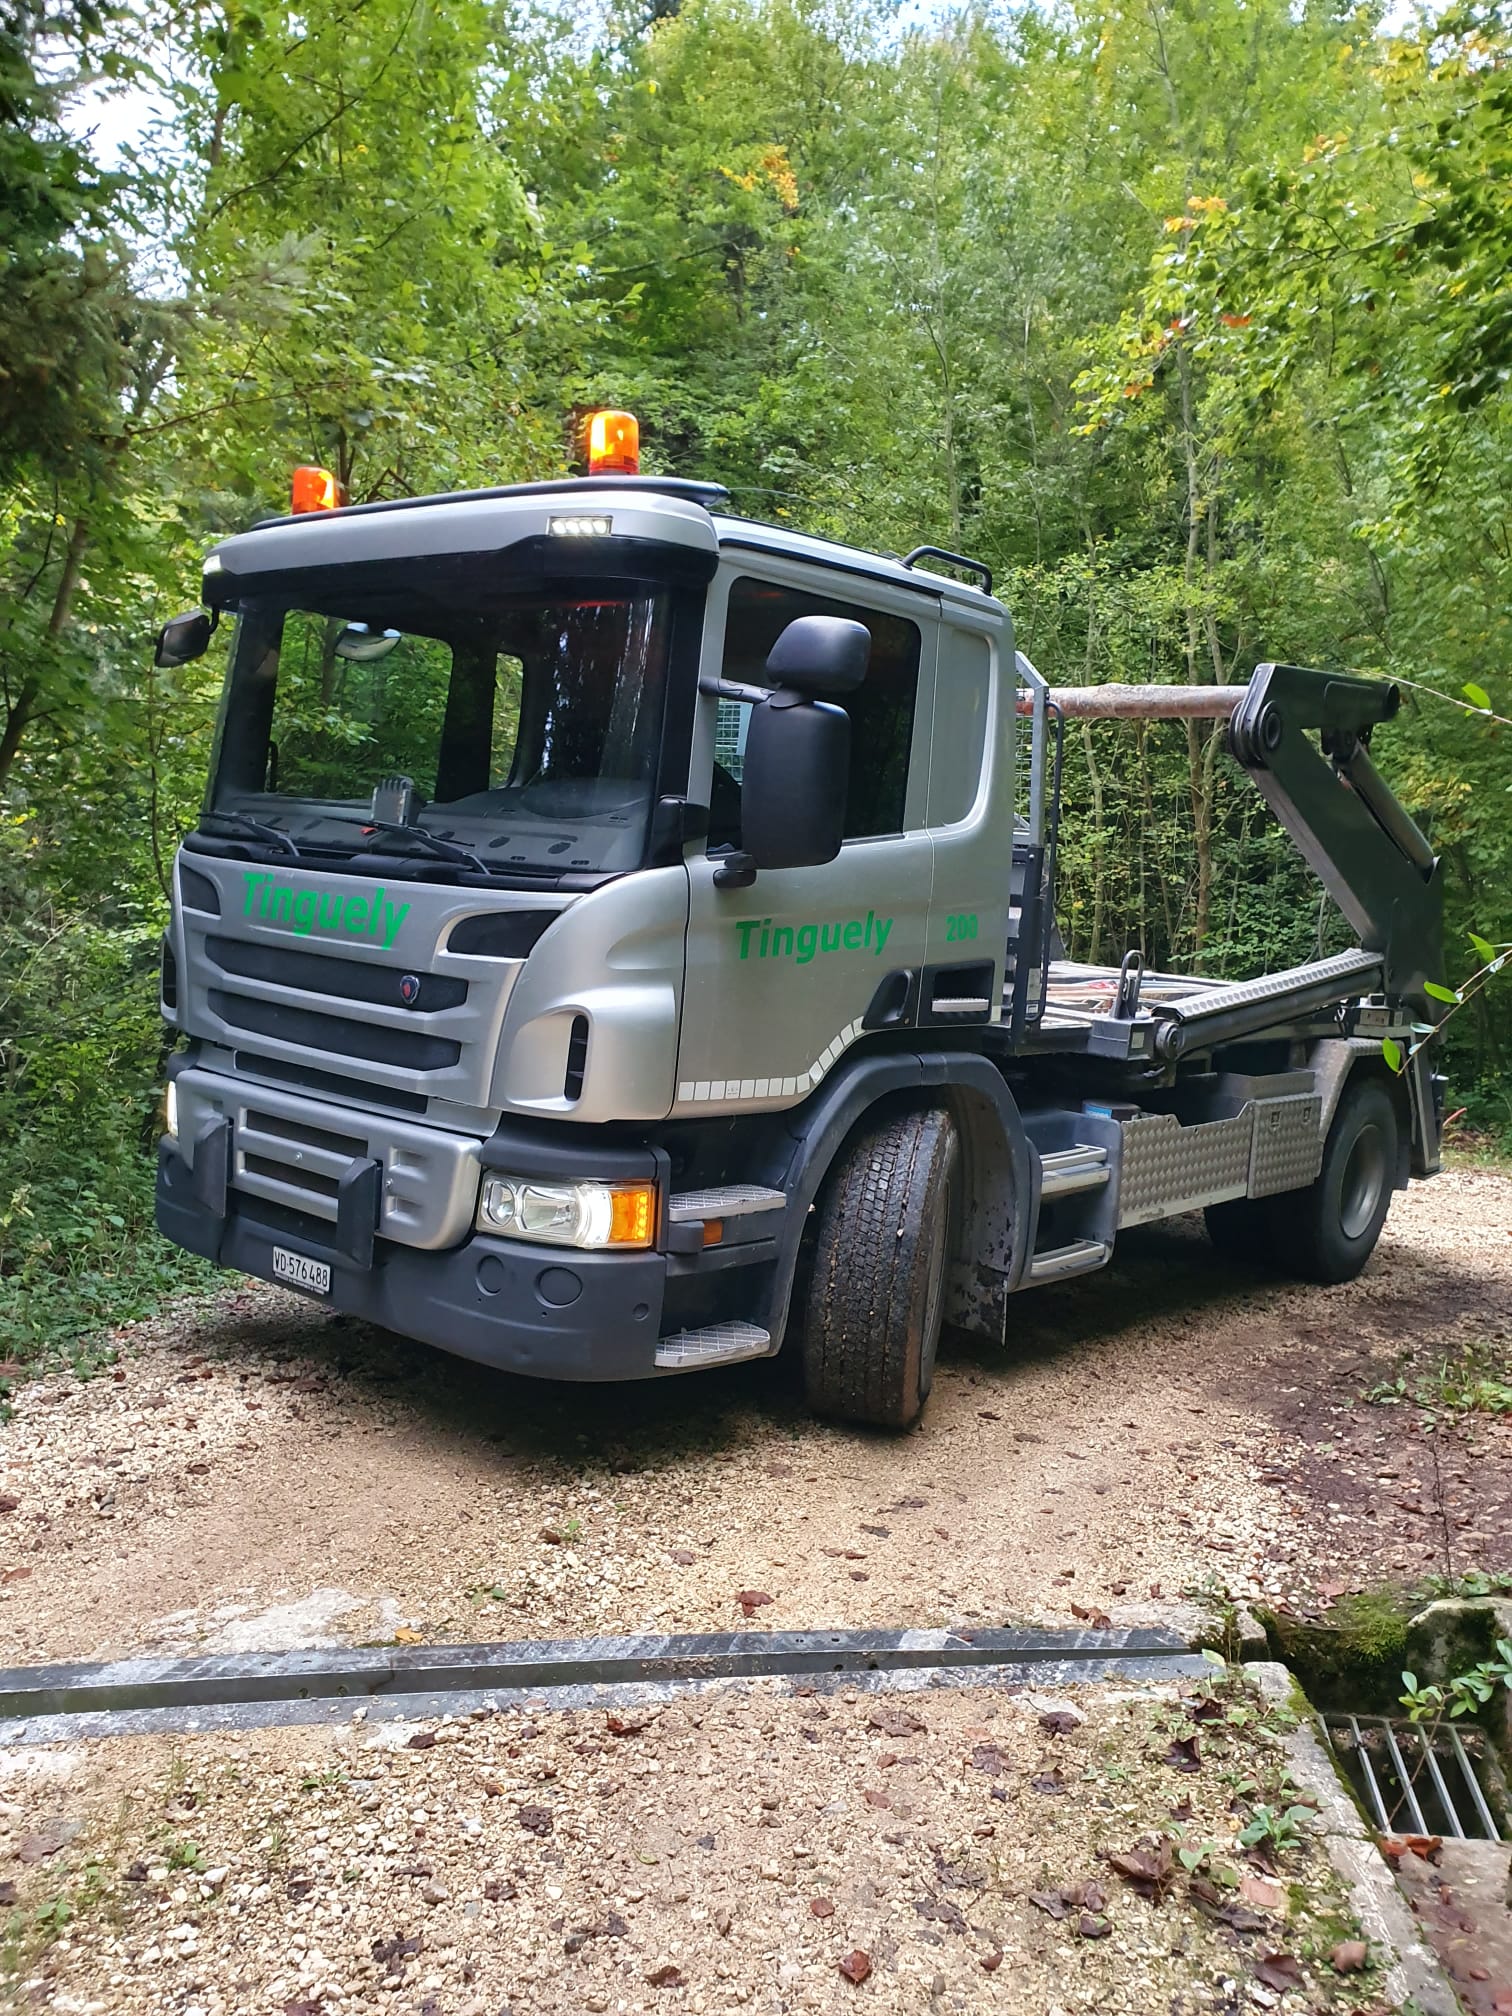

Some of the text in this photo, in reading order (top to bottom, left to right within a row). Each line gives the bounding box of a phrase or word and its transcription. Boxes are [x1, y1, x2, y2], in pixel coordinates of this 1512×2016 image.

[243, 872, 411, 950] Tinguely
[735, 910, 894, 965] Tinguely
[945, 914, 979, 943] 200
